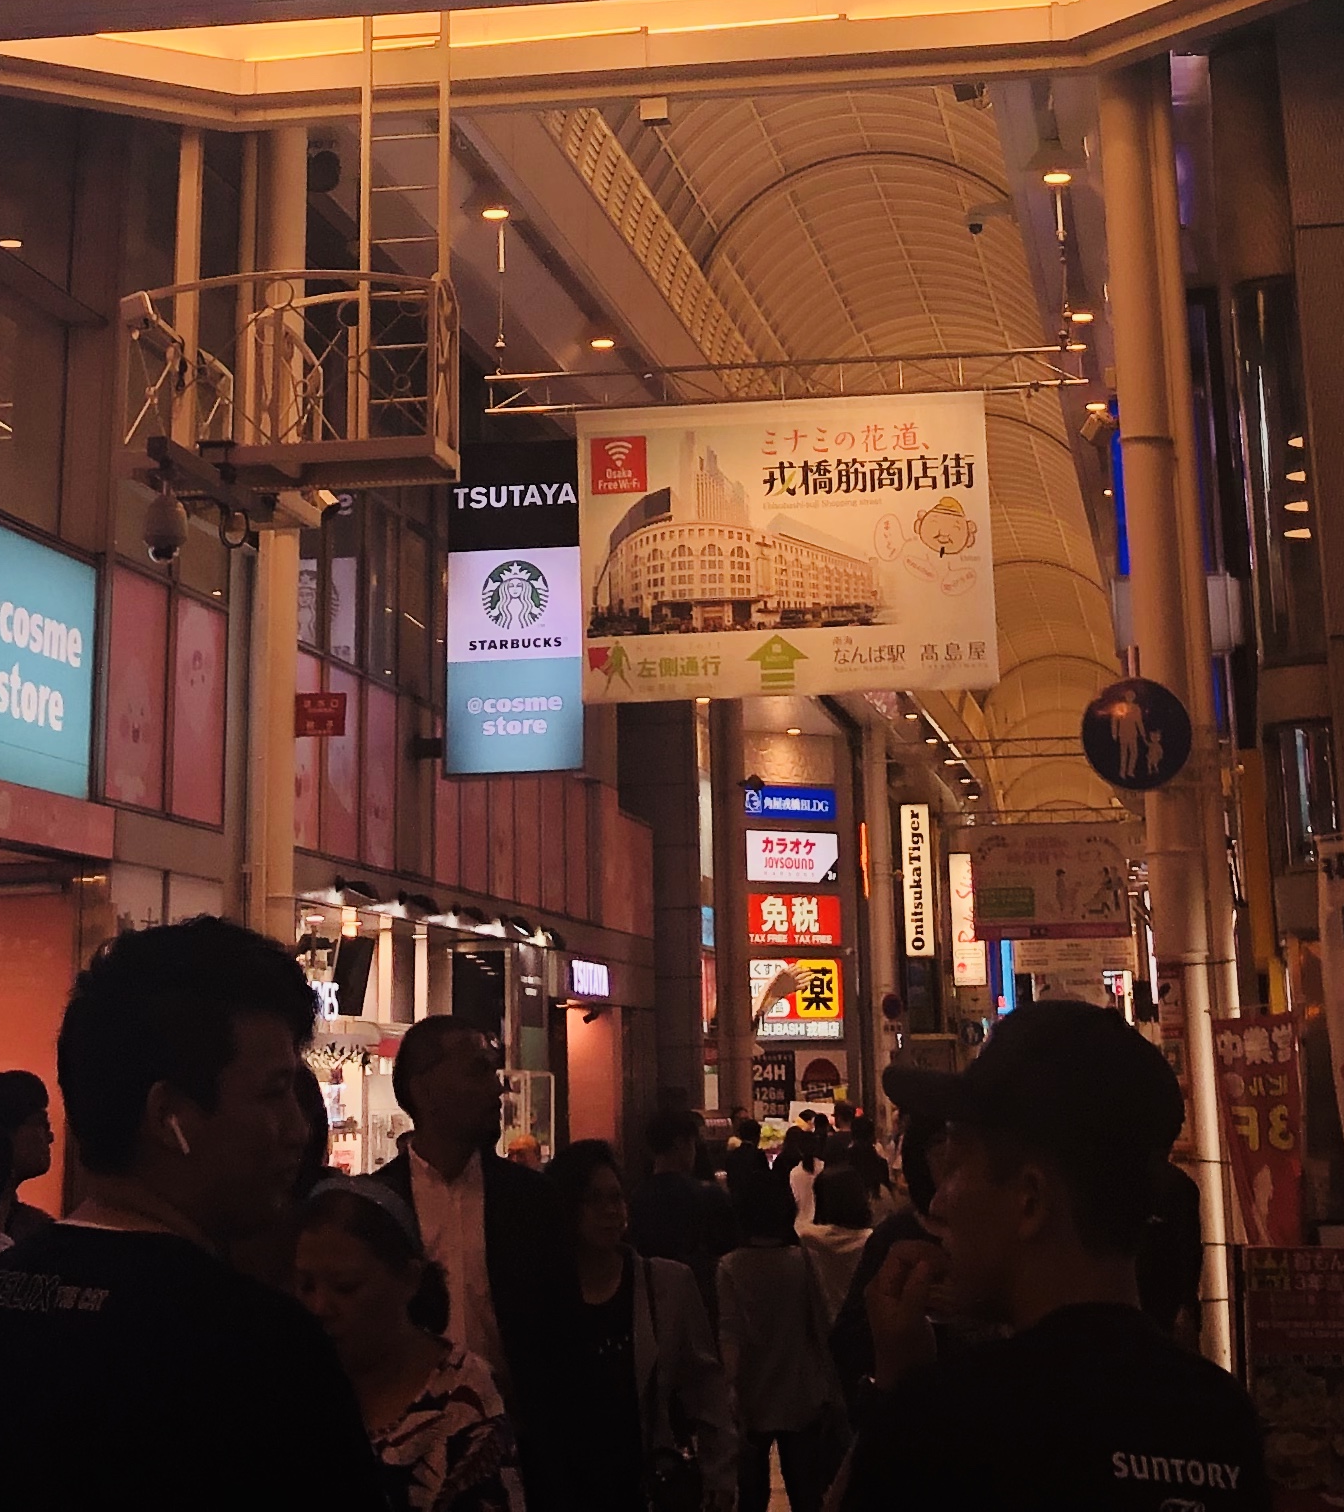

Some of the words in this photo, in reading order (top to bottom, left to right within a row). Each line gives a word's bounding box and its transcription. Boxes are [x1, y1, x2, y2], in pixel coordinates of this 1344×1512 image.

[762, 422, 930, 455] ミナミの花道、
[605, 468, 633, 479] Osaka
[763, 452, 975, 497] 戎橋筋商店街
[454, 483, 576, 510] TSUTAYA
[468, 637, 563, 651] STARBUCKS
[833, 644, 906, 664] なんば駅
[637, 656, 721, 678] 左側通行
[467, 694, 563, 715] @cosme
[482, 715, 548, 736] store
[762, 837, 816, 855] カラオケ
[764, 856, 815, 870] JOYSOUND
[761, 896, 819, 933] 免税
[749, 934, 765, 943] TAX
[767, 934, 788, 943] FREE
[794, 934, 810, 944] TAX
[811, 935, 832, 944] FREE
[753, 1064, 785, 1081] 24H
